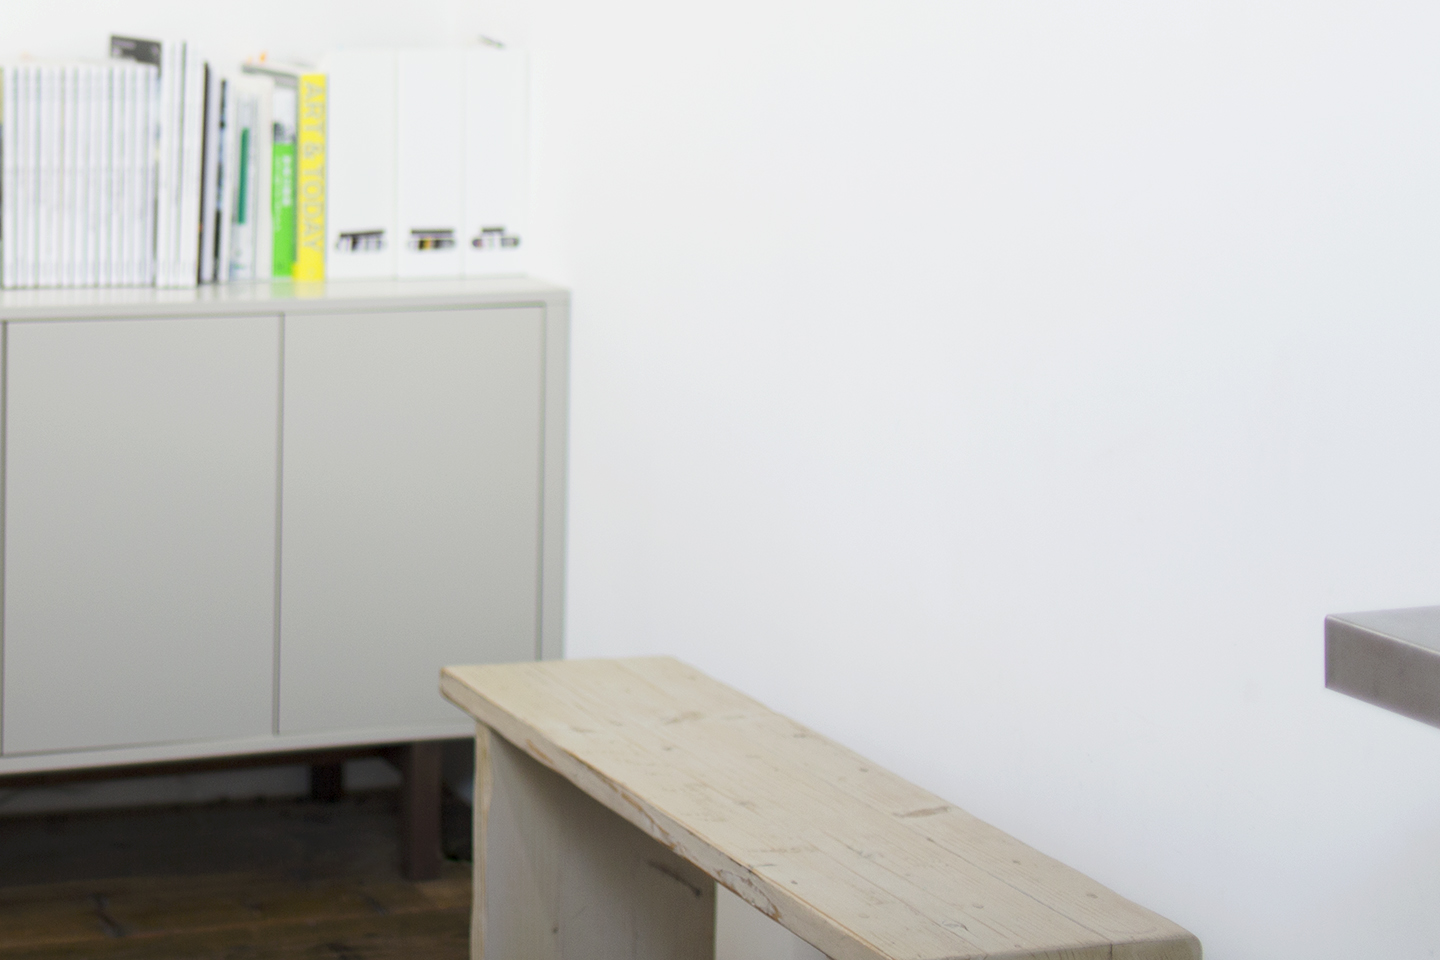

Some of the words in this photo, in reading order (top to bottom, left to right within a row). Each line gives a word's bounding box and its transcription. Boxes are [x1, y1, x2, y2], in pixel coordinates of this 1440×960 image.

[304, 82, 324, 136] ART
[304, 142, 323, 159] &
[303, 167, 324, 252] TODAY
